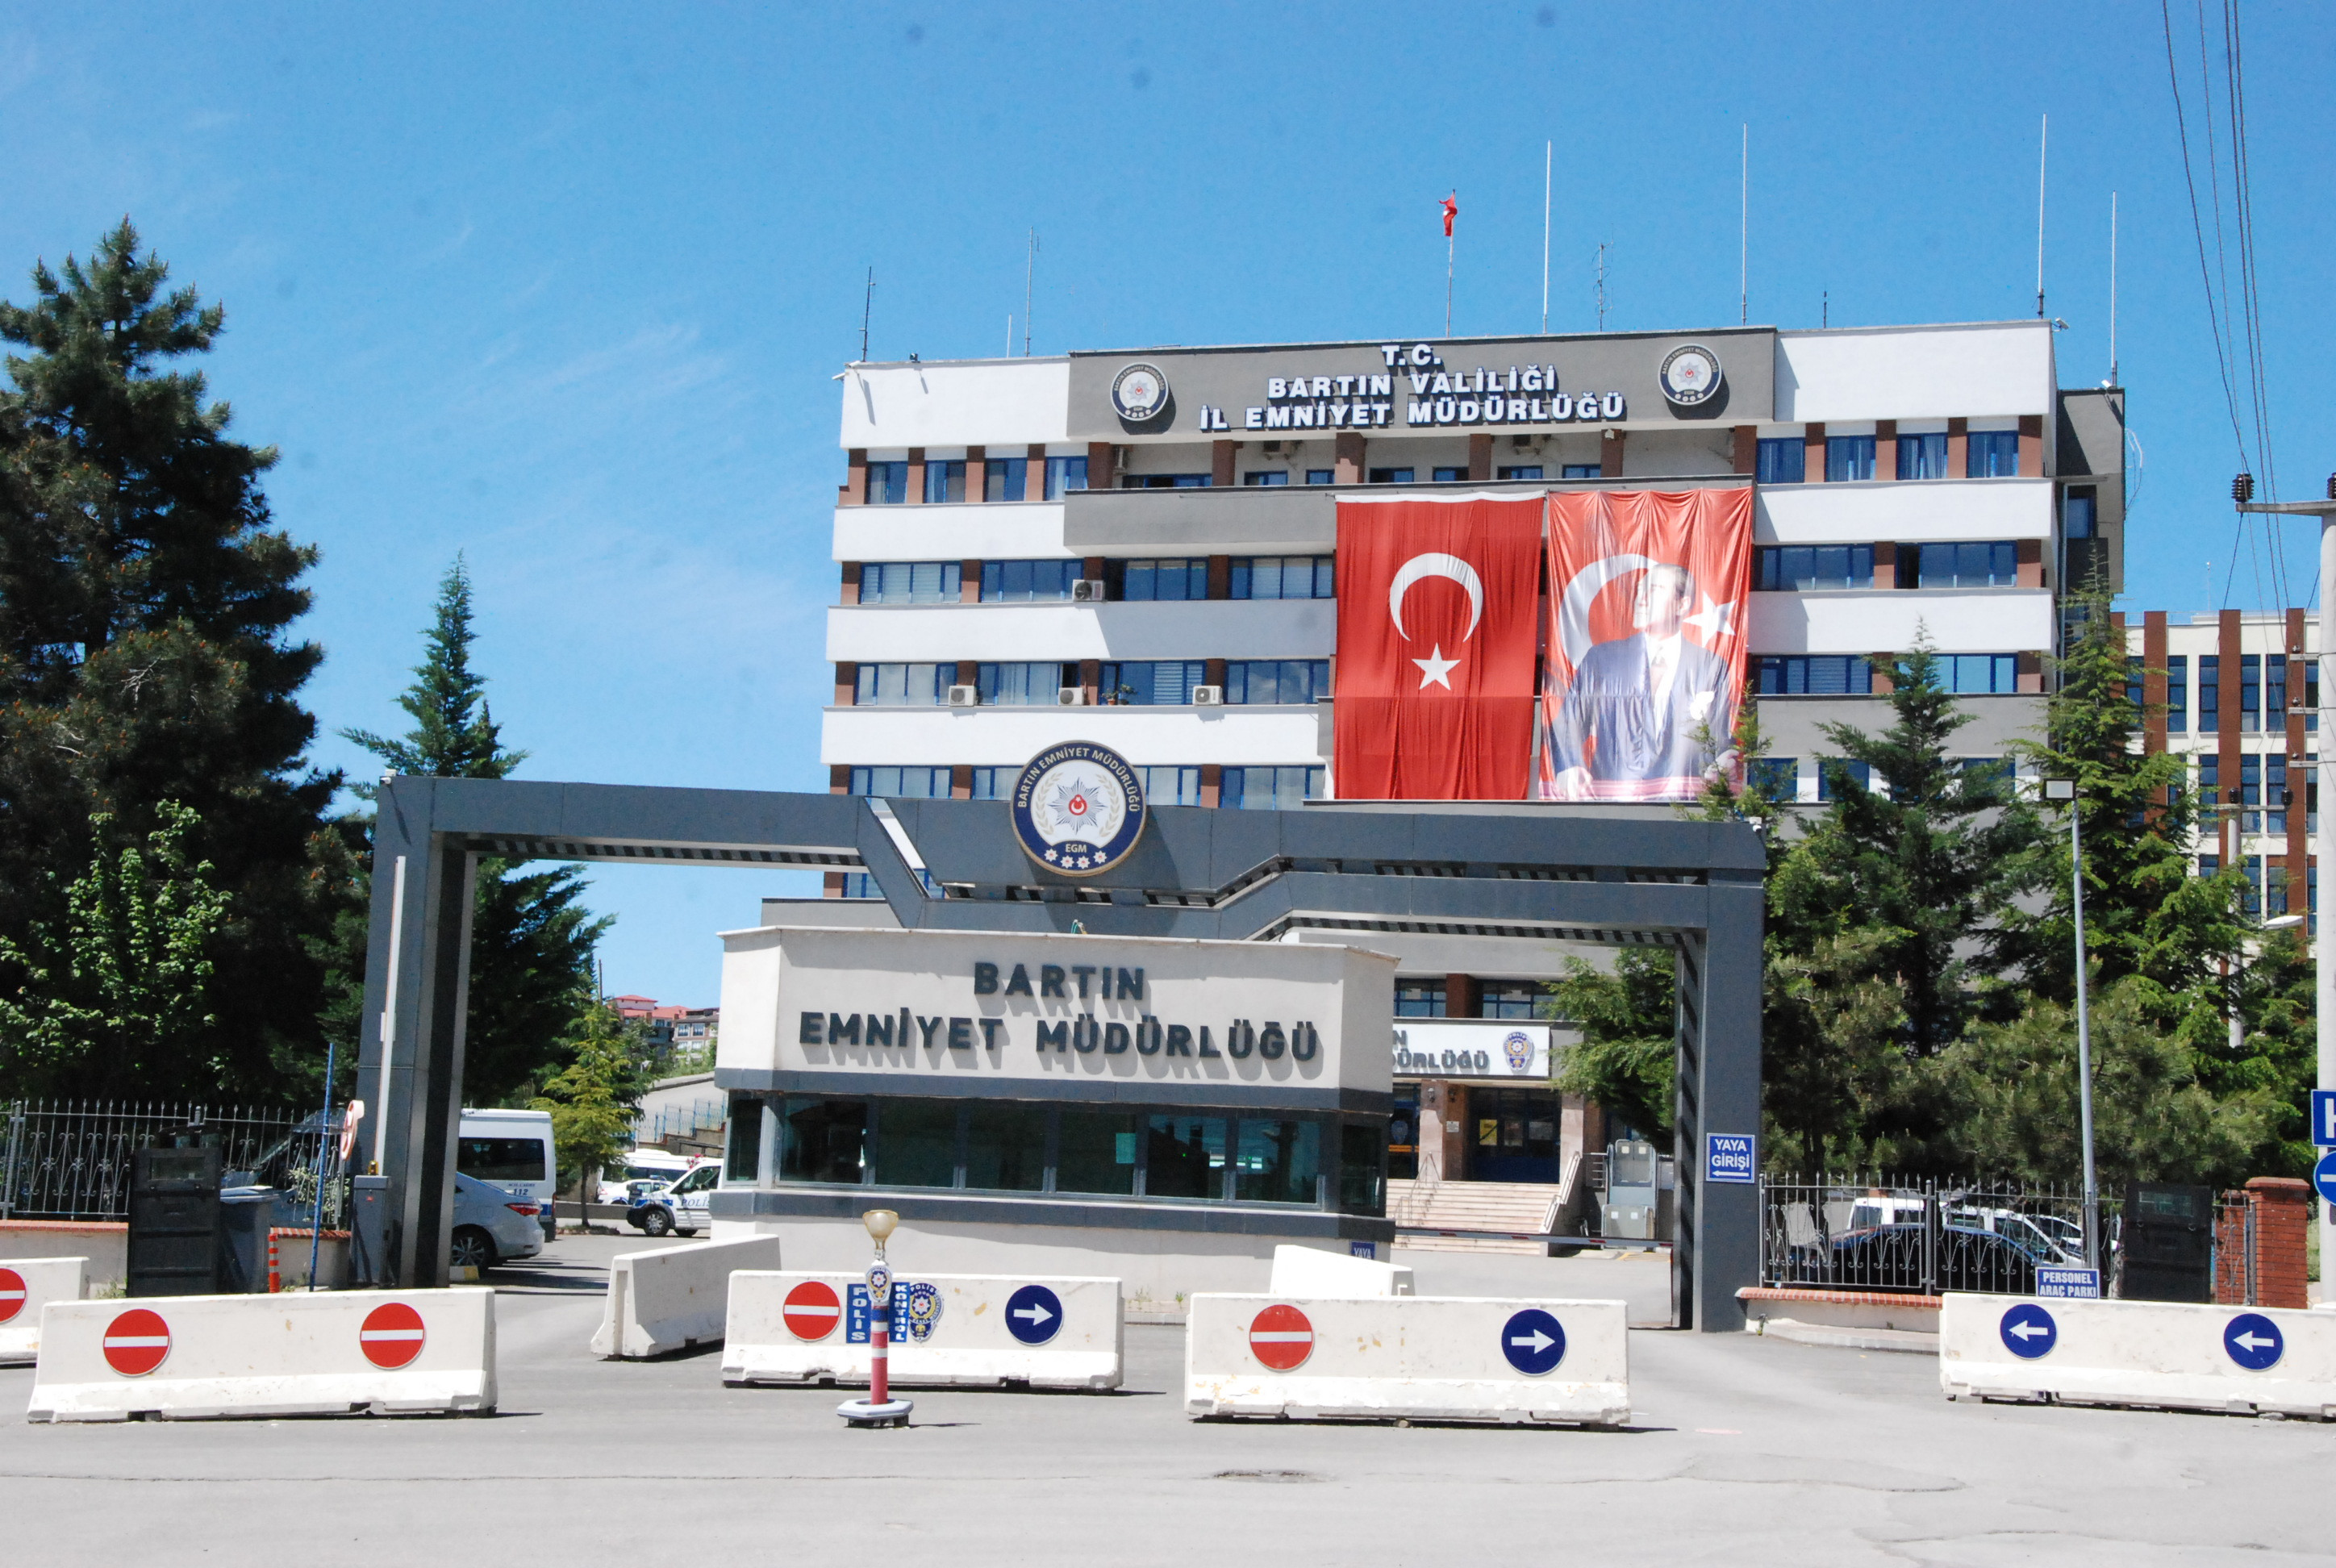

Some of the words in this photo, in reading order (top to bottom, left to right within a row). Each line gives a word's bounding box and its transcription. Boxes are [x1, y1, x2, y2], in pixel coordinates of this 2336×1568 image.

[1267, 373, 1391, 398] BARTIN
[1410, 365, 1555, 394] VALİLİĞİ
[1199, 404, 1228, 430] İL
[1245, 400, 1391, 429] EMNİYET
[1408, 391, 1624, 423] MÜDÜRLÜĞÜ
[1018, 767, 1041, 808] BARTIN
[1039, 747, 1090, 769] EMNİYET
[1091, 749, 1141, 812] MÜDÜRLÜĞÜ
[1065, 844, 1087, 853] EGM
[974, 961, 1144, 1001] BARTIN
[799, 1007, 1003, 1050] EMNİYET
[1036, 1013, 1317, 1061] MÜDÜRLÜĞÜ
[1392, 1048, 1489, 1069] ÜRLÜĞÜ
[1714, 1138, 1747, 1152] YAYA
[1711, 1153, 1750, 1170] GİRİŞİ
[513, 1188, 528, 1196] 112
[1354, 1247, 1372, 1259] YAYA
[2042, 1271, 2093, 1284] PERSONEL
[910, 1283, 936, 1292] POLİS
[2039, 1285, 2065, 1297] ARAÇ
[2067, 1286, 2096, 1298] PARKI
[851, 1287, 868, 1341] POLİS
[895, 1284, 908, 1341] KONTROL
